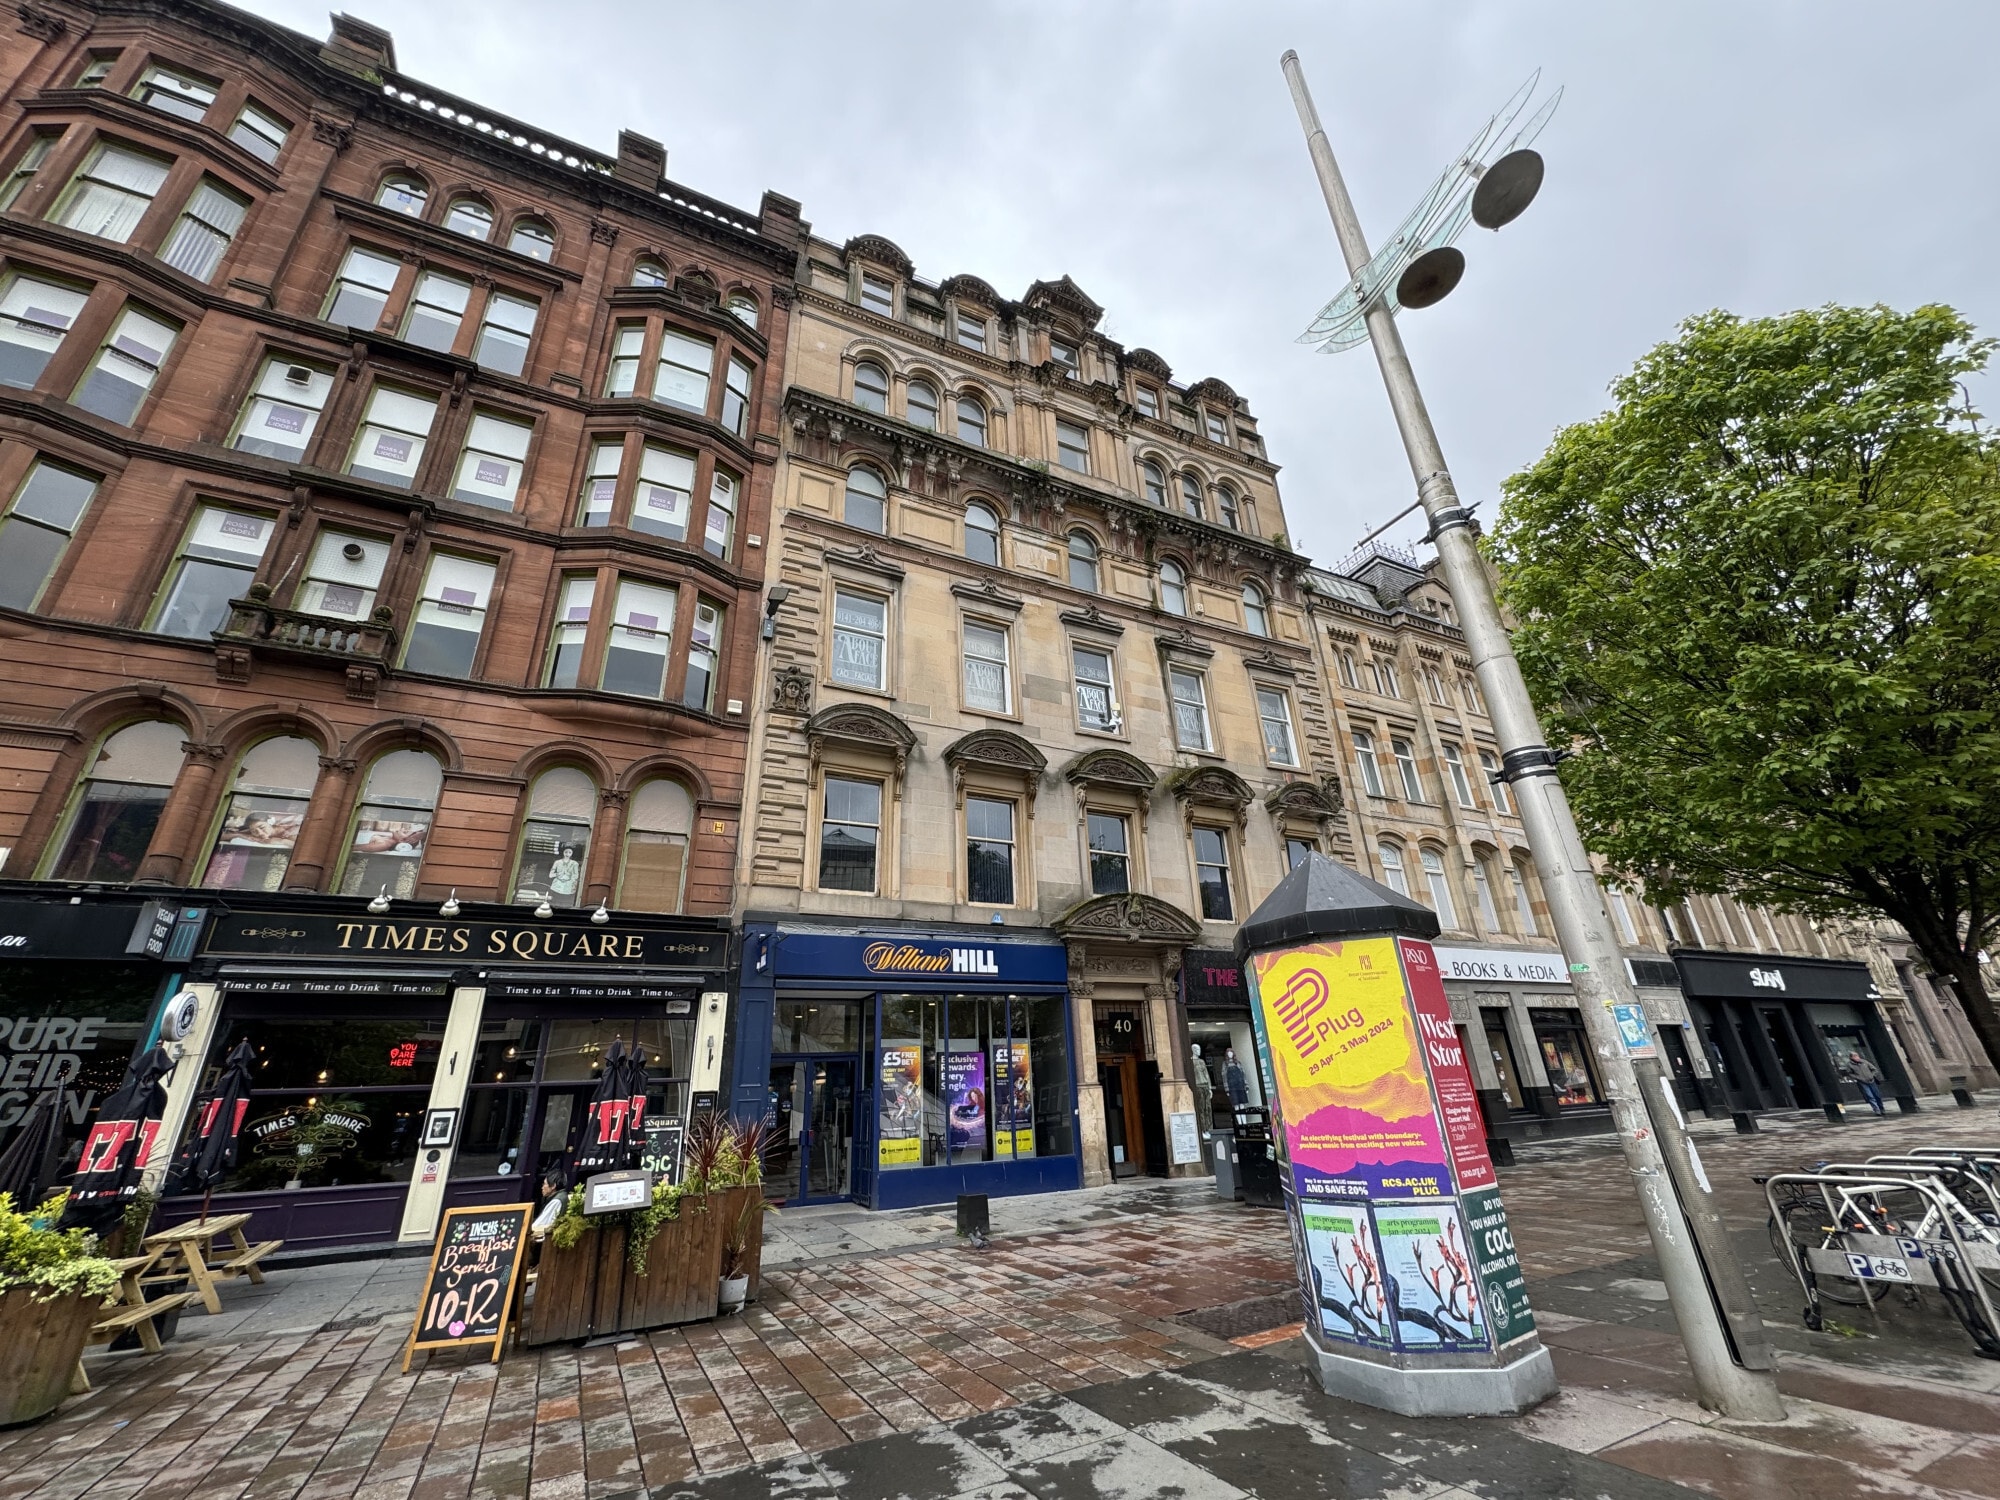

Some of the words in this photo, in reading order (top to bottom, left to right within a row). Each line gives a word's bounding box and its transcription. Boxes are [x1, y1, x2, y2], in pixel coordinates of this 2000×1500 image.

[266, 421, 300, 432] LIDDELL
[375, 450, 406, 461] LIDDELL
[476, 475, 506, 486] LIDDELL
[222, 525, 257, 537] LIDDELL
[157, 907, 176, 925] VEGAN
[153, 923, 168, 938] FAST
[147, 938, 163, 953] FOOD
[337, 922, 470, 952] TIMES
[487, 929, 644, 960] SQUARE
[863, 941, 954, 973] William
[952, 948, 999, 974] HILL
[1404, 947, 1429, 965] RSNO
[1203, 967, 1238, 987] THE
[1452, 961, 1498, 978] BOOKS
[1503, 964, 1513, 978] &
[1518, 964, 1558, 980] MEDIA
[222, 980, 251, 990] Time
[255, 981, 267, 990] to
[270, 982, 291, 991] Eat
[303, 982, 330, 991] Time
[334, 984, 346, 992] to
[349, 984, 380, 992] Drink
[392, 985, 417, 993] Time
[505, 986, 529, 995] Time
[532, 987, 541, 995] to
[544, 987, 561, 996] Eat
[569, 987, 594, 996] Time
[597, 988, 604, 996] to
[607, 988, 632, 997] Drink
[641, 989, 662, 997] Time
[1114, 1019, 1132, 1033] 40
[1316, 1007, 1365, 1042] Plug
[1418, 1013, 1457, 1040] West
[401, 1043, 418, 1051] YOU
[1308, 1063, 1320, 1076] 29
[1319, 1054, 1335, 1069] Apr
[1340, 1044, 1349, 1054] 3
[1347, 1033, 1369, 1050] May
[1367, 1018, 1394, 1039] 2024
[1430, 1040, 1462, 1067] Stor
[398, 1051, 416, 1059] ARE
[883, 1051, 901, 1067] £5
[902, 1058, 915, 1066] BET
[253, 1115, 296, 1137] TIMES
[323, 1113, 366, 1133] SQUARE
[1310, 1133, 1342, 1142] electrifying
[1343, 1132, 1368, 1140] festival
[1368, 1132, 1385, 1140] with
[1385, 1130, 1421, 1140] boundary-
[1300, 1142, 1322, 1150] pushing
[1341, 1140, 1356, 1148] from
[1356, 1140, 1384, 1149] exciting
[1401, 1138, 1428, 1147] voices.
[1307, 1184, 1324, 1193] AND
[1325, 1185, 1347, 1195] SAVE
[1347, 1187, 1369, 1196] 20%
[1381, 1177, 1438, 1188] RCS.AC.UK/
[1412, 1186, 1440, 1196] PLUG
[1483, 1199, 1493, 1211] DO
[1387, 1219, 1399, 1227] arts
[1399, 1219, 1439, 1229] programme
[1469, 1217, 1483, 1231] YOU
[1482, 1214, 1498, 1228] HAVE
[1497, 1213, 1503, 1223] A
[1899, 1240, 1919, 1258] P
[1481, 1256, 1508, 1276] ALCOHOL
[1506, 1254, 1517, 1266] OR
[1847, 1254, 1868, 1278] P
[424, 1278, 499, 1331] 10-12
